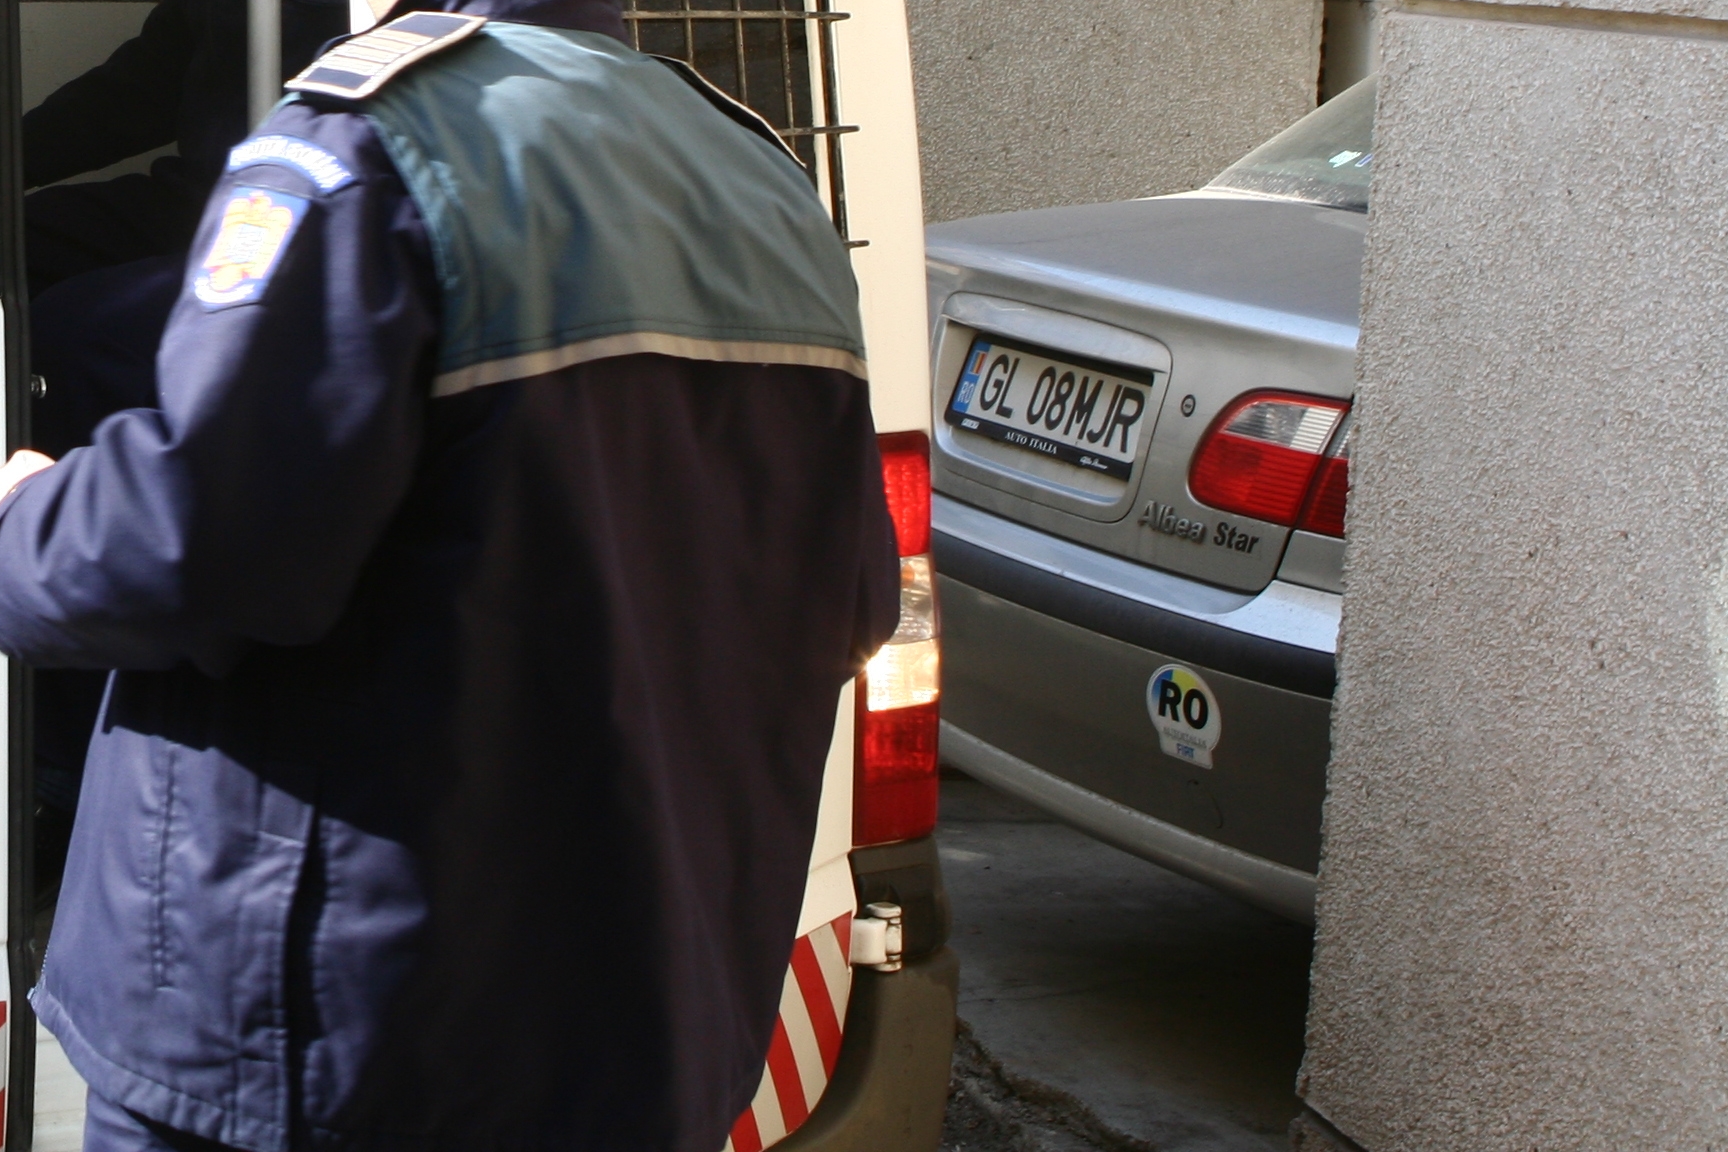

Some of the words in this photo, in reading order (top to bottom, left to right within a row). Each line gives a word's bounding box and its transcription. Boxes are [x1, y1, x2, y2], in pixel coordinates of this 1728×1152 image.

[958, 380, 976, 404] RO
[979, 354, 1021, 419] GL
[1005, 431, 1028, 446] AUTO
[1028, 438, 1057, 455] ITALIA
[1137, 500, 1207, 546] Albea
[1213, 521, 1260, 554] Star
[1158, 679, 1210, 730] RO
